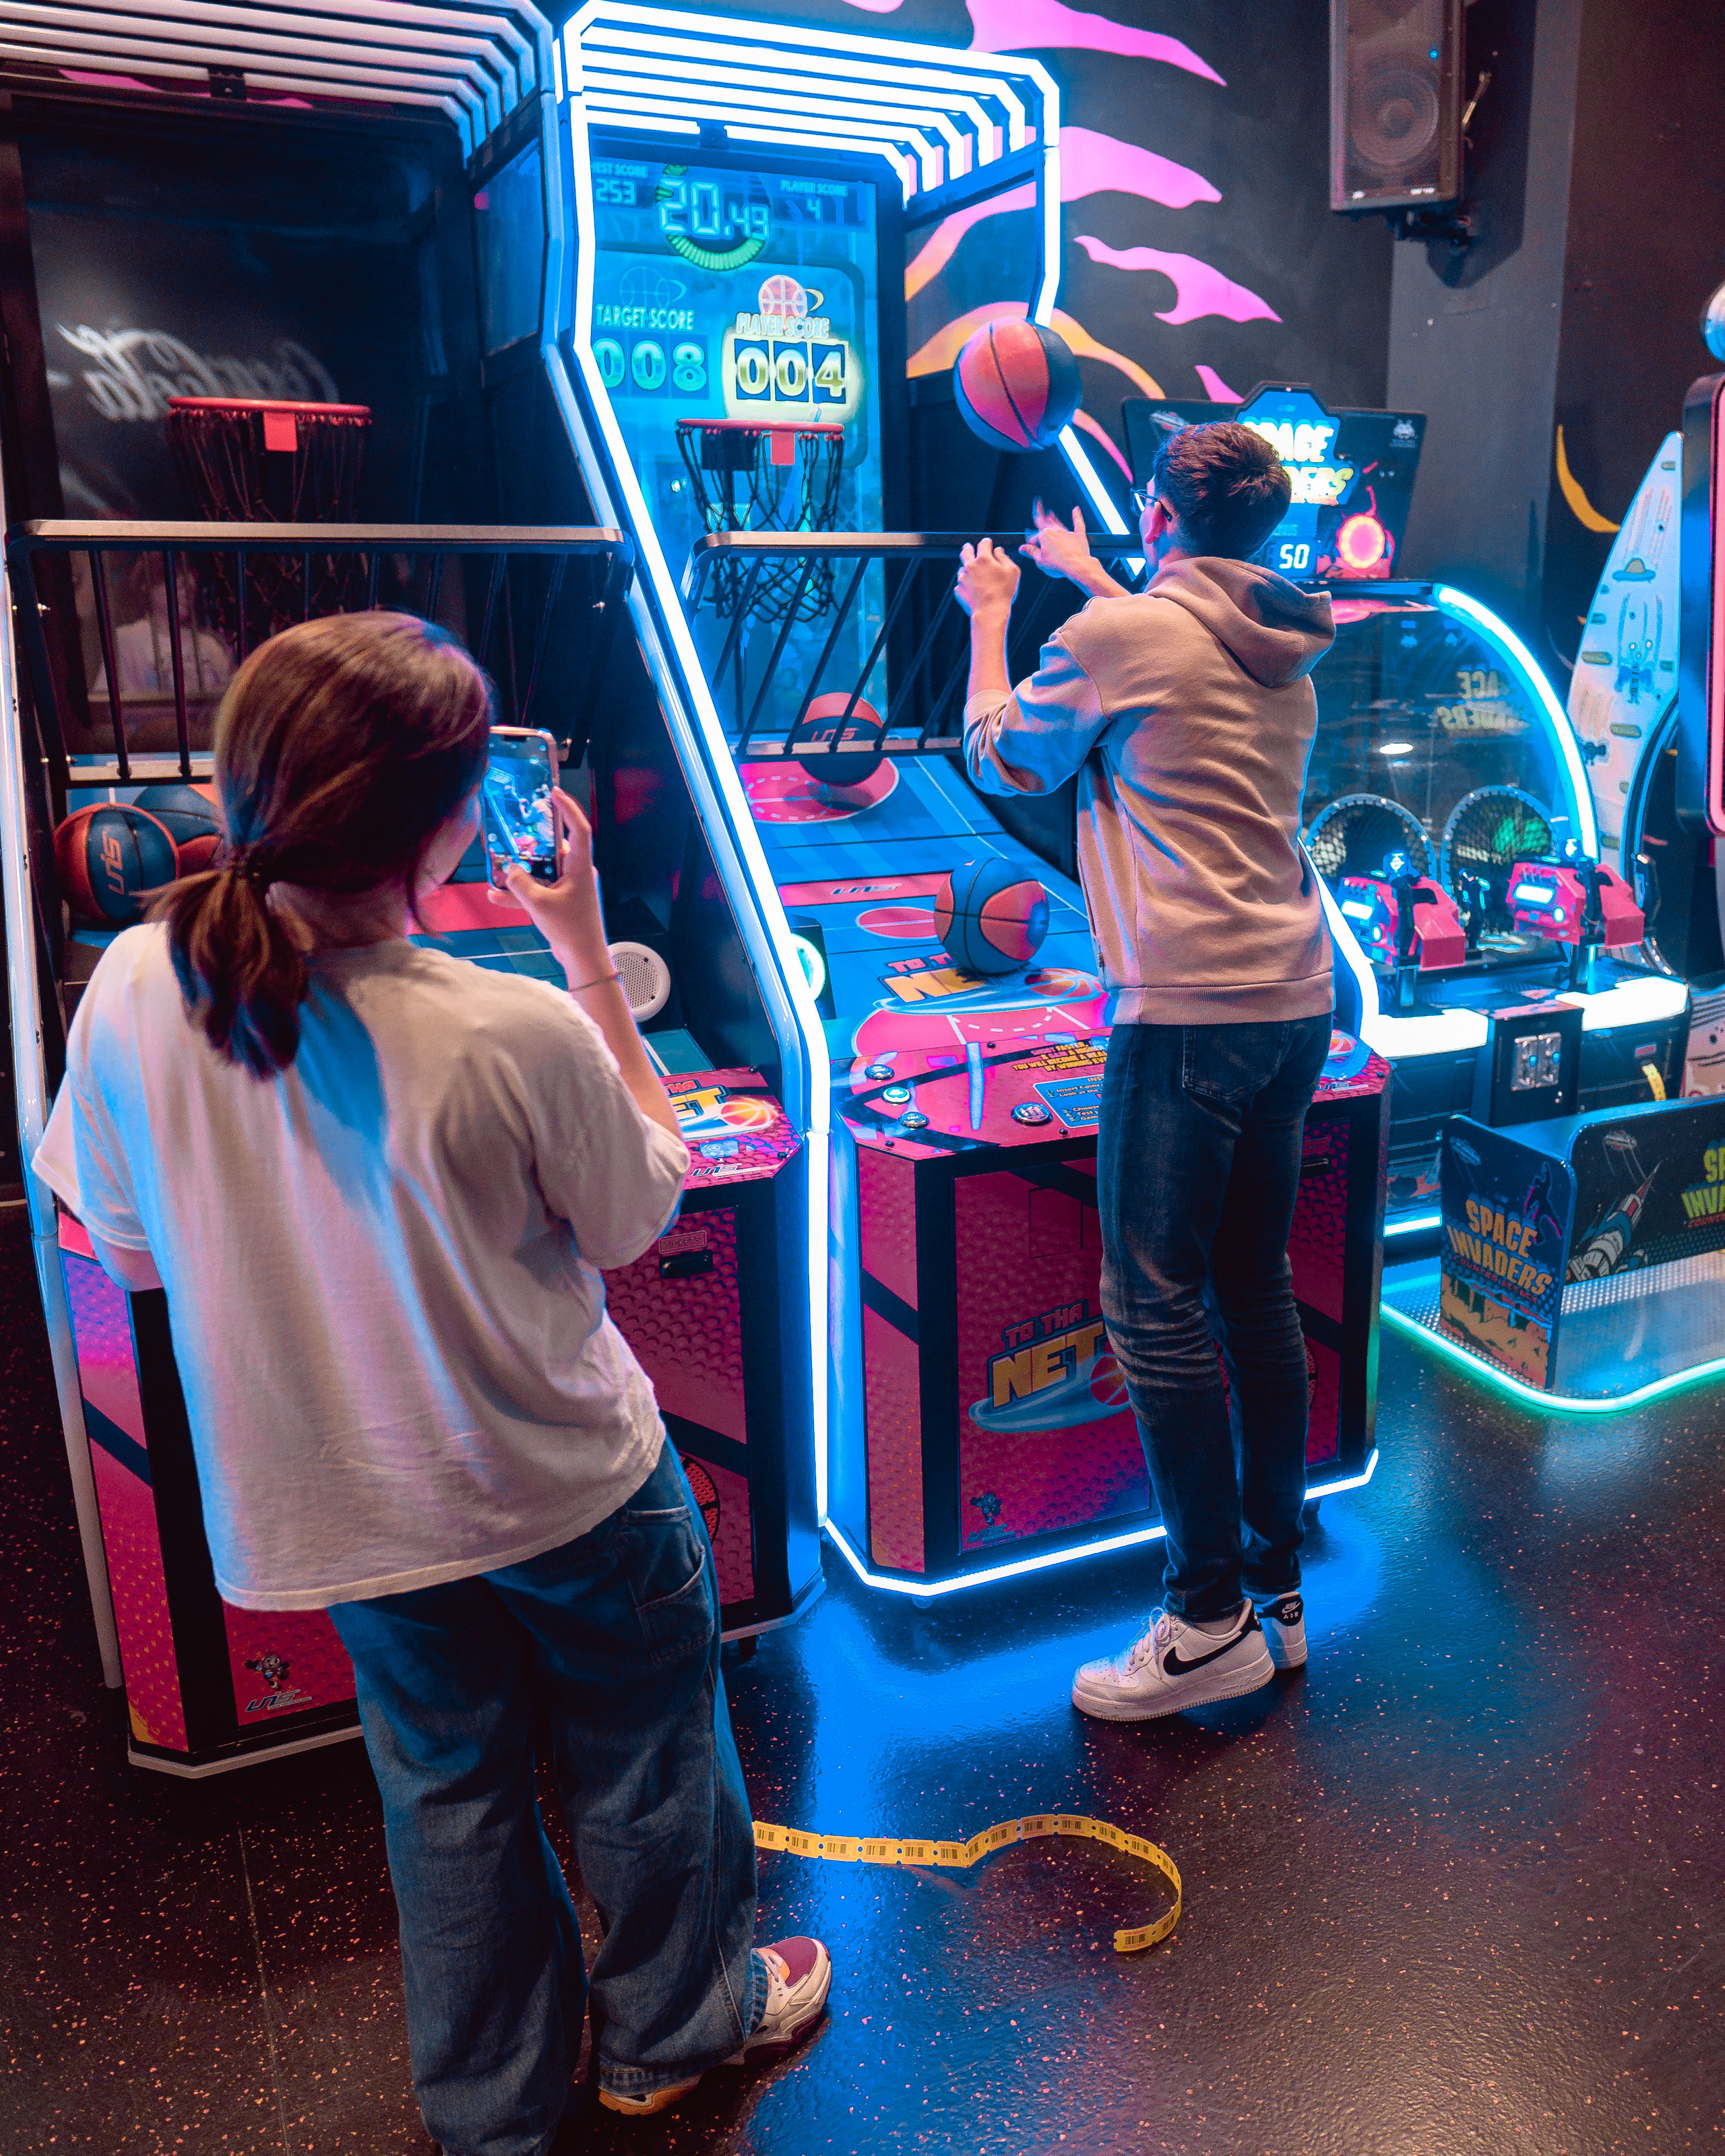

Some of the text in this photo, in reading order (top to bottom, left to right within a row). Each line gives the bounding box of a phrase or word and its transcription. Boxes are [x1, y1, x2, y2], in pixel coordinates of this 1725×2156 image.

[614, 162, 648, 178] SCORE
[596, 178, 635, 205] 253
[817, 183, 848, 197] SCORE
[659, 177, 770, 239] 20.49
[595, 304, 695, 331] TARGET SCORE
[736, 311, 830, 338] PLAYER SCORE
[592, 338, 708, 393] 008
[736, 346, 846, 398] 004
[1279, 544, 1311, 569] 50
[888, 958, 926, 972] TO
[1012, 1063, 1030, 1071] YOU
[1028, 1060, 1048, 1069] WILL
[668, 1087, 722, 1120] ET
[665, 1236, 701, 1248] TICKETS
[1466, 1199, 1538, 1259] SPACE
[1447, 1224, 1552, 1296] INVADERS
[1005, 1304, 1083, 1344] TO THA
[993, 1321, 1104, 1408] NET
[1283, 1612, 1299, 1620] AIR
